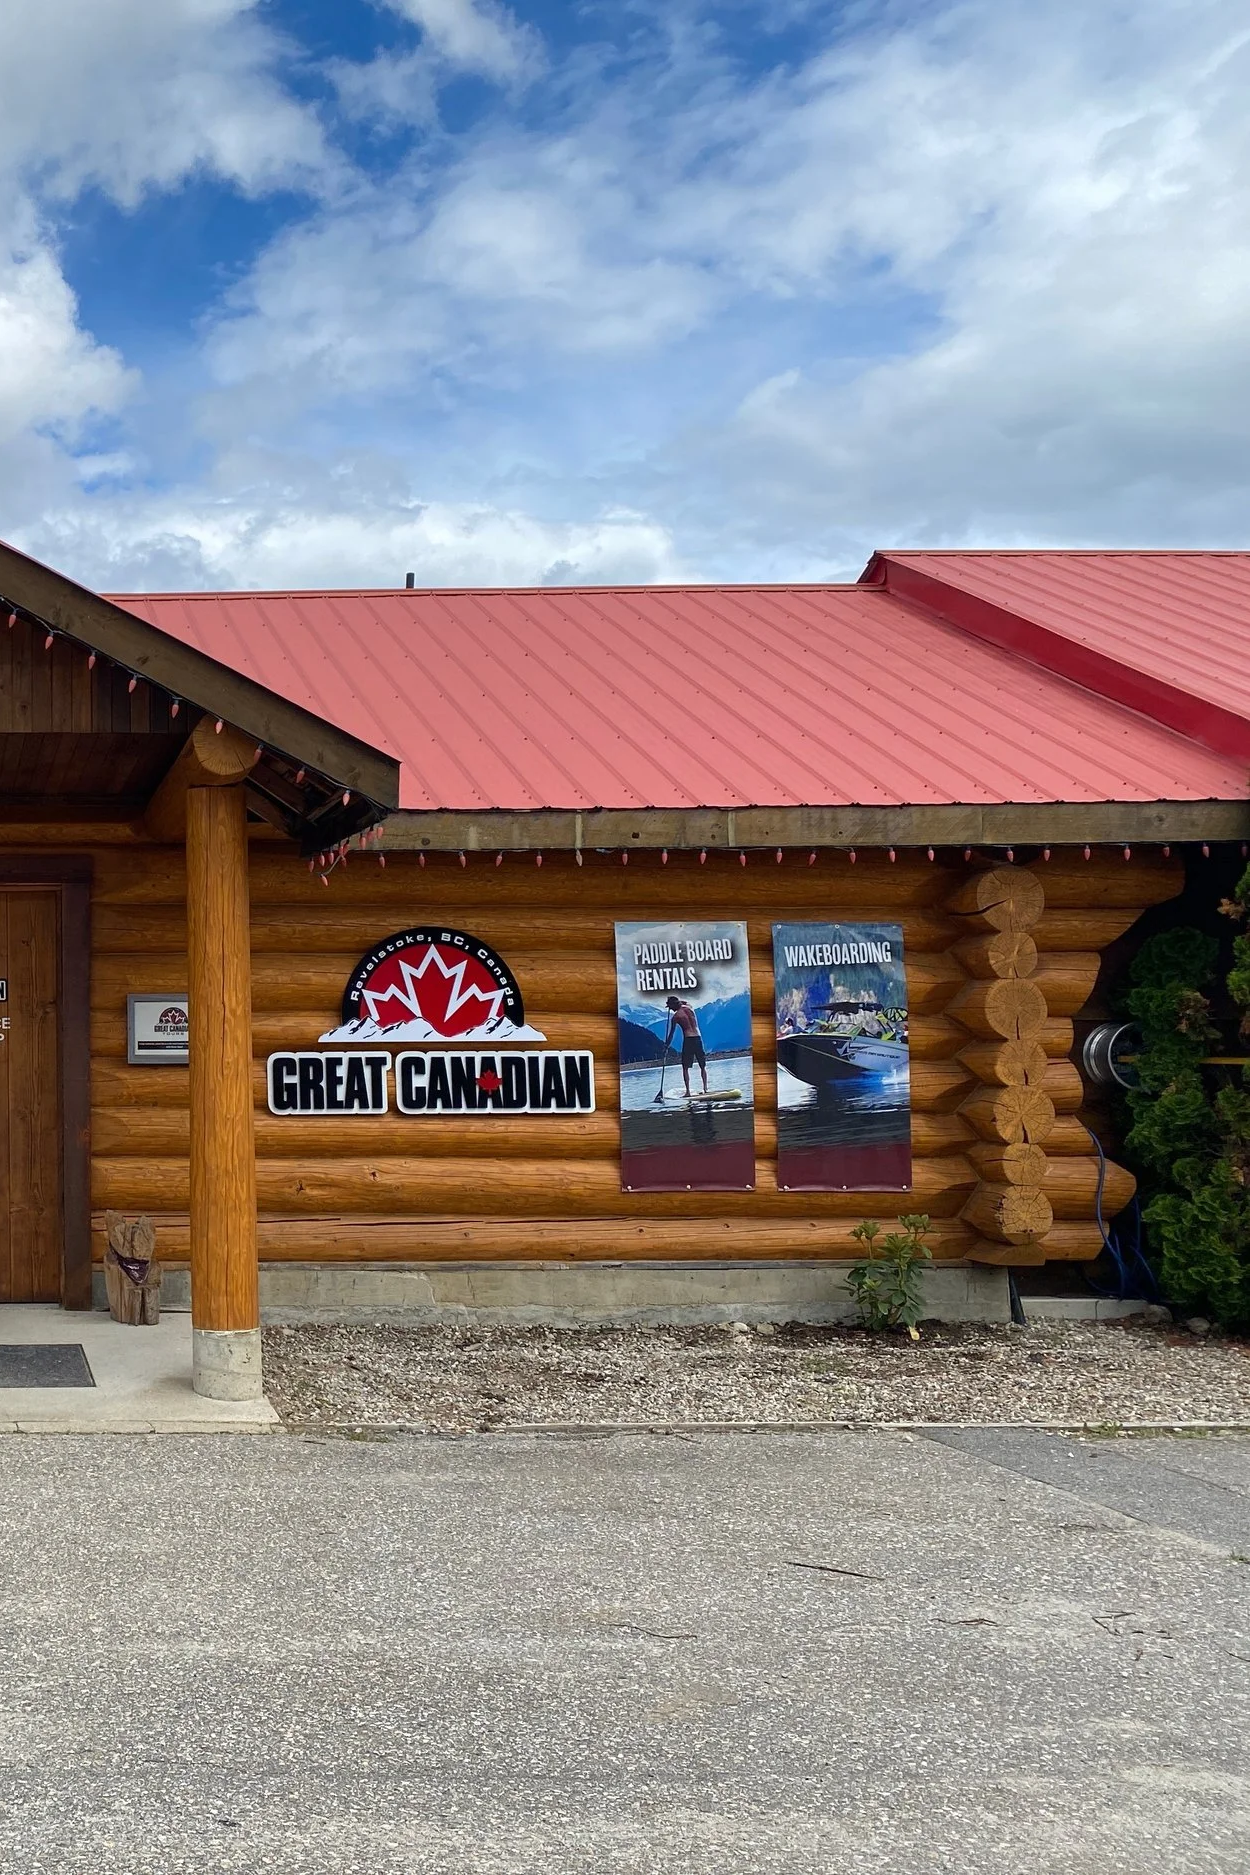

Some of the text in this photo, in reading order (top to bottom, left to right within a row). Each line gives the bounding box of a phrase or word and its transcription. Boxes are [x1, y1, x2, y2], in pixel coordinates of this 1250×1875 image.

[633, 938, 733, 965] PADDLE BOARD
[784, 941, 892, 968] WAKEBOARDING
[350, 933, 515, 1006] Revelstoke, BC, Canada
[636, 966, 698, 991] RENTALS
[154, 1025, 169, 1033] GREAT
[272, 1055, 592, 1110] GREAT CANADIAN
